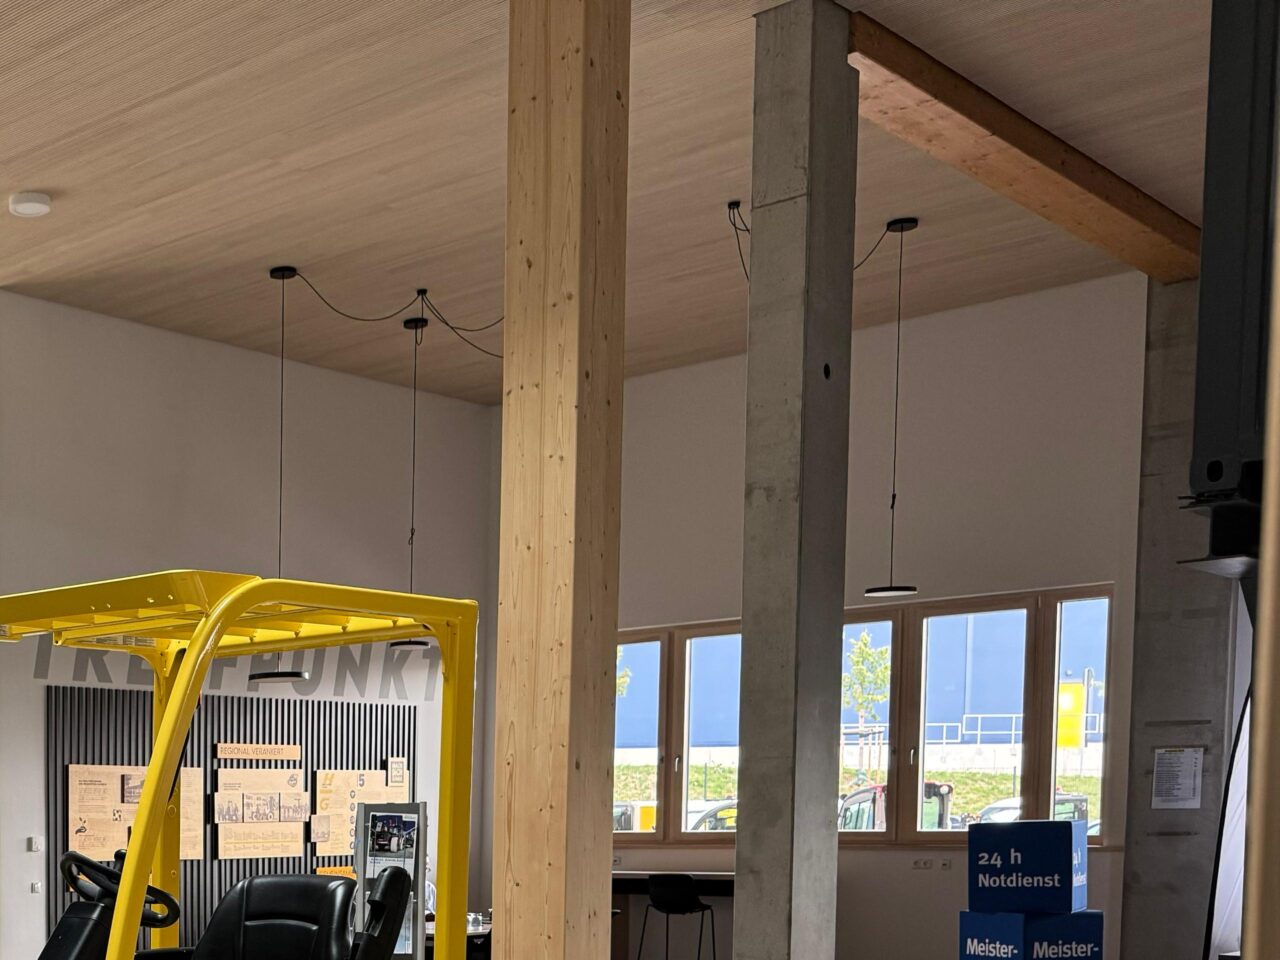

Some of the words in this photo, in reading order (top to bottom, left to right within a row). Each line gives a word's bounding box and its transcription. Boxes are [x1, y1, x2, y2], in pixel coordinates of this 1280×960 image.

[220, 747, 250, 756] REGIONAL
[251, 748, 284, 756] VERANKERT
[978, 852, 1002, 868] 24
[1010, 848, 1022, 864] h
[978, 873, 1061, 887] Notdienst
[966, 938, 1018, 958] Meister-
[1032, 940, 1099, 959] Meister-
